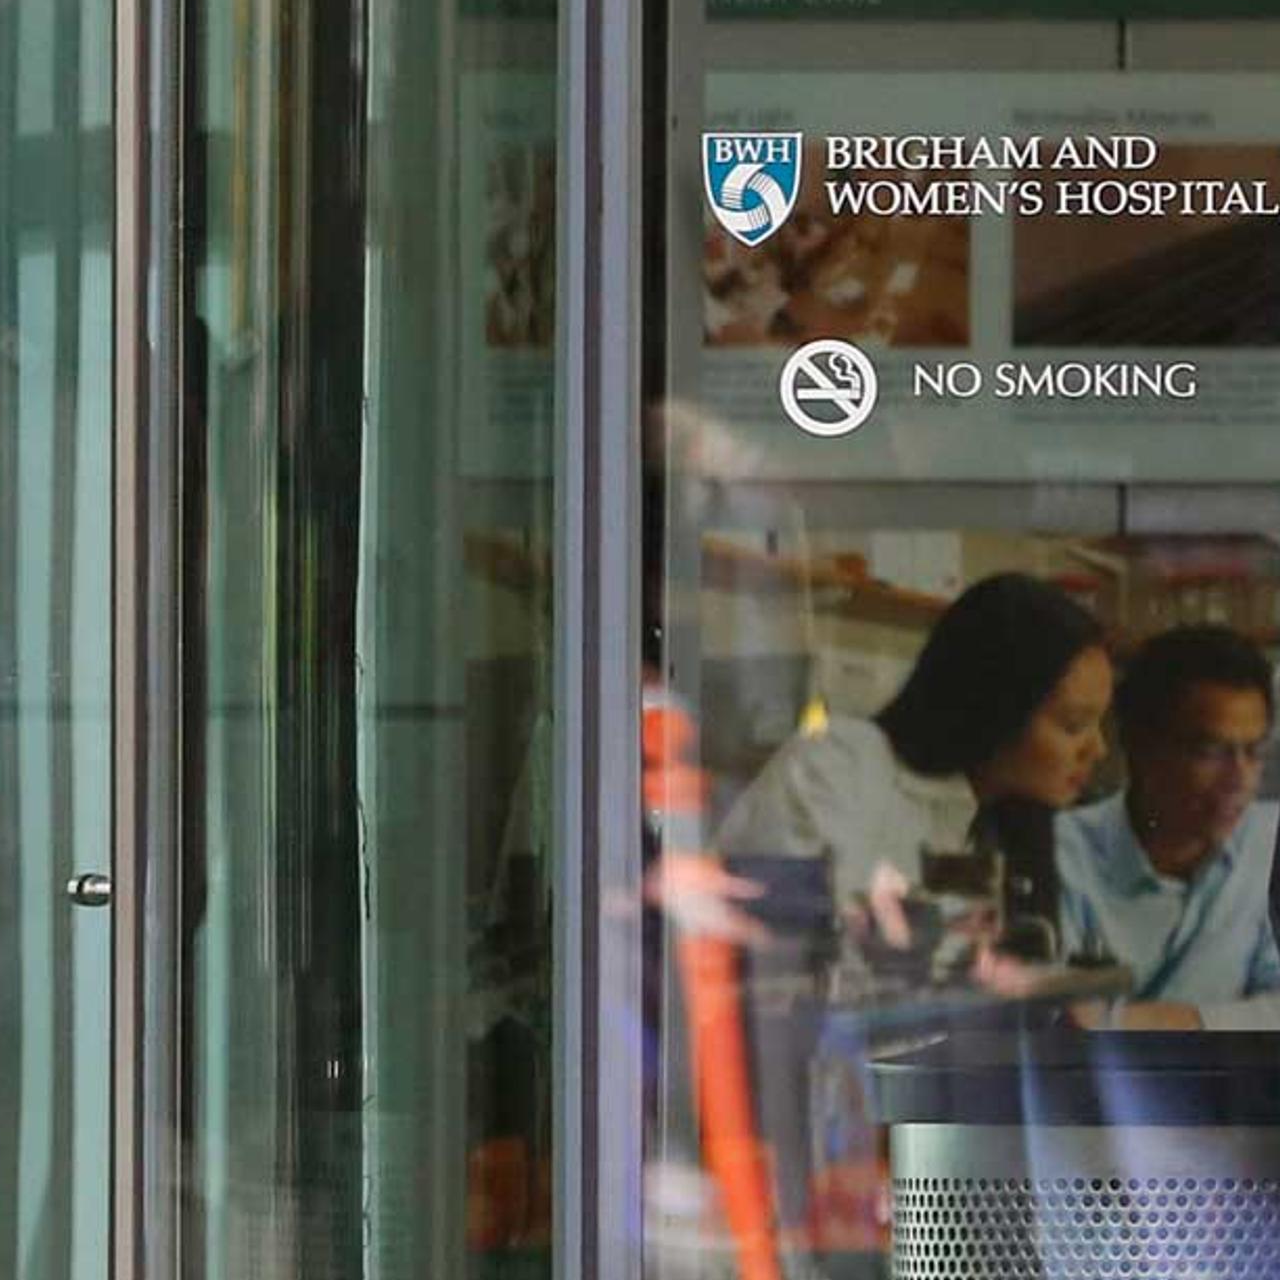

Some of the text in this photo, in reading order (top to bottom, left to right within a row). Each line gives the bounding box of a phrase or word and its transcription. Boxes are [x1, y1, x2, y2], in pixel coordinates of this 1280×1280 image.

[715, 139, 790, 164] BWH
[826, 136, 1157, 170] BRIGHAM AND
[825, 181, 1279, 215] WOMEN'S HOSPITAL
[914, 363, 1196, 398] NO SMOKING
